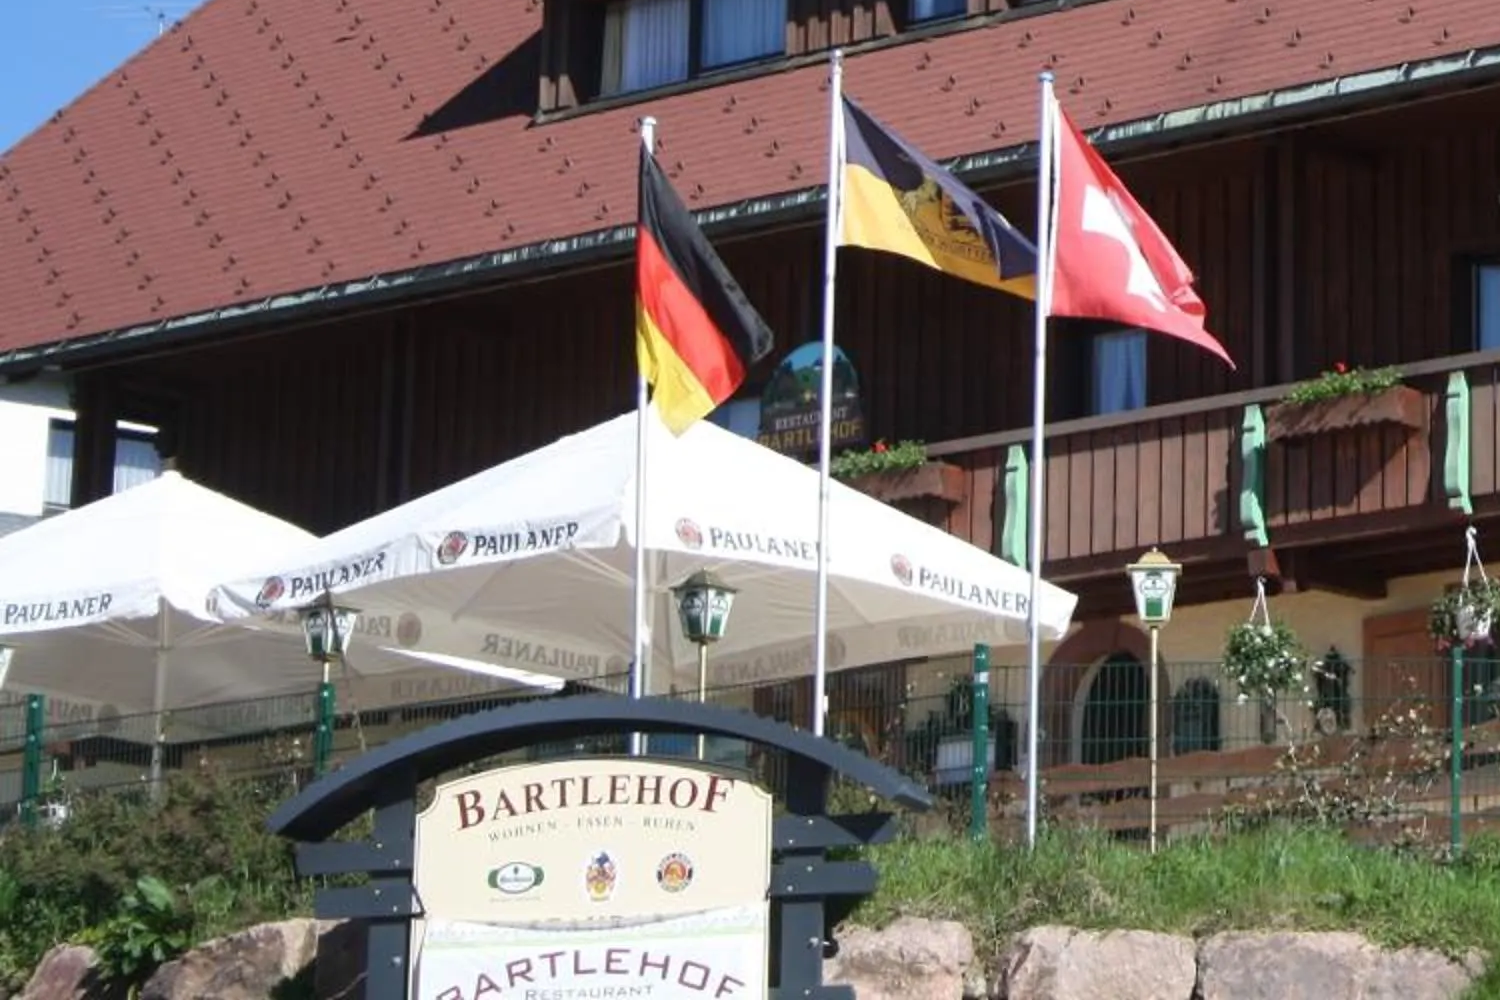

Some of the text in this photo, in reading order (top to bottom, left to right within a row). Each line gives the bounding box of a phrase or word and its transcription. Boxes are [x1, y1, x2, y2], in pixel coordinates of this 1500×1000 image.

[774, 406, 848, 430] RESTAUNT
[758, 420, 862, 451] BARTLHOF
[471, 522, 578, 556] PAULANER
[290, 551, 386, 598] PAULANER
[4, 593, 112, 624] PAULANER
[919, 572, 1028, 614] PAULANER
[455, 774, 735, 831] BARTLEHOF
[488, 820, 558, 842] WOHNEN
[577, 815, 624, 828] ESSEN
[643, 815, 695, 831] RUHEN
[525, 985, 653, 1000] RESTAURANT
